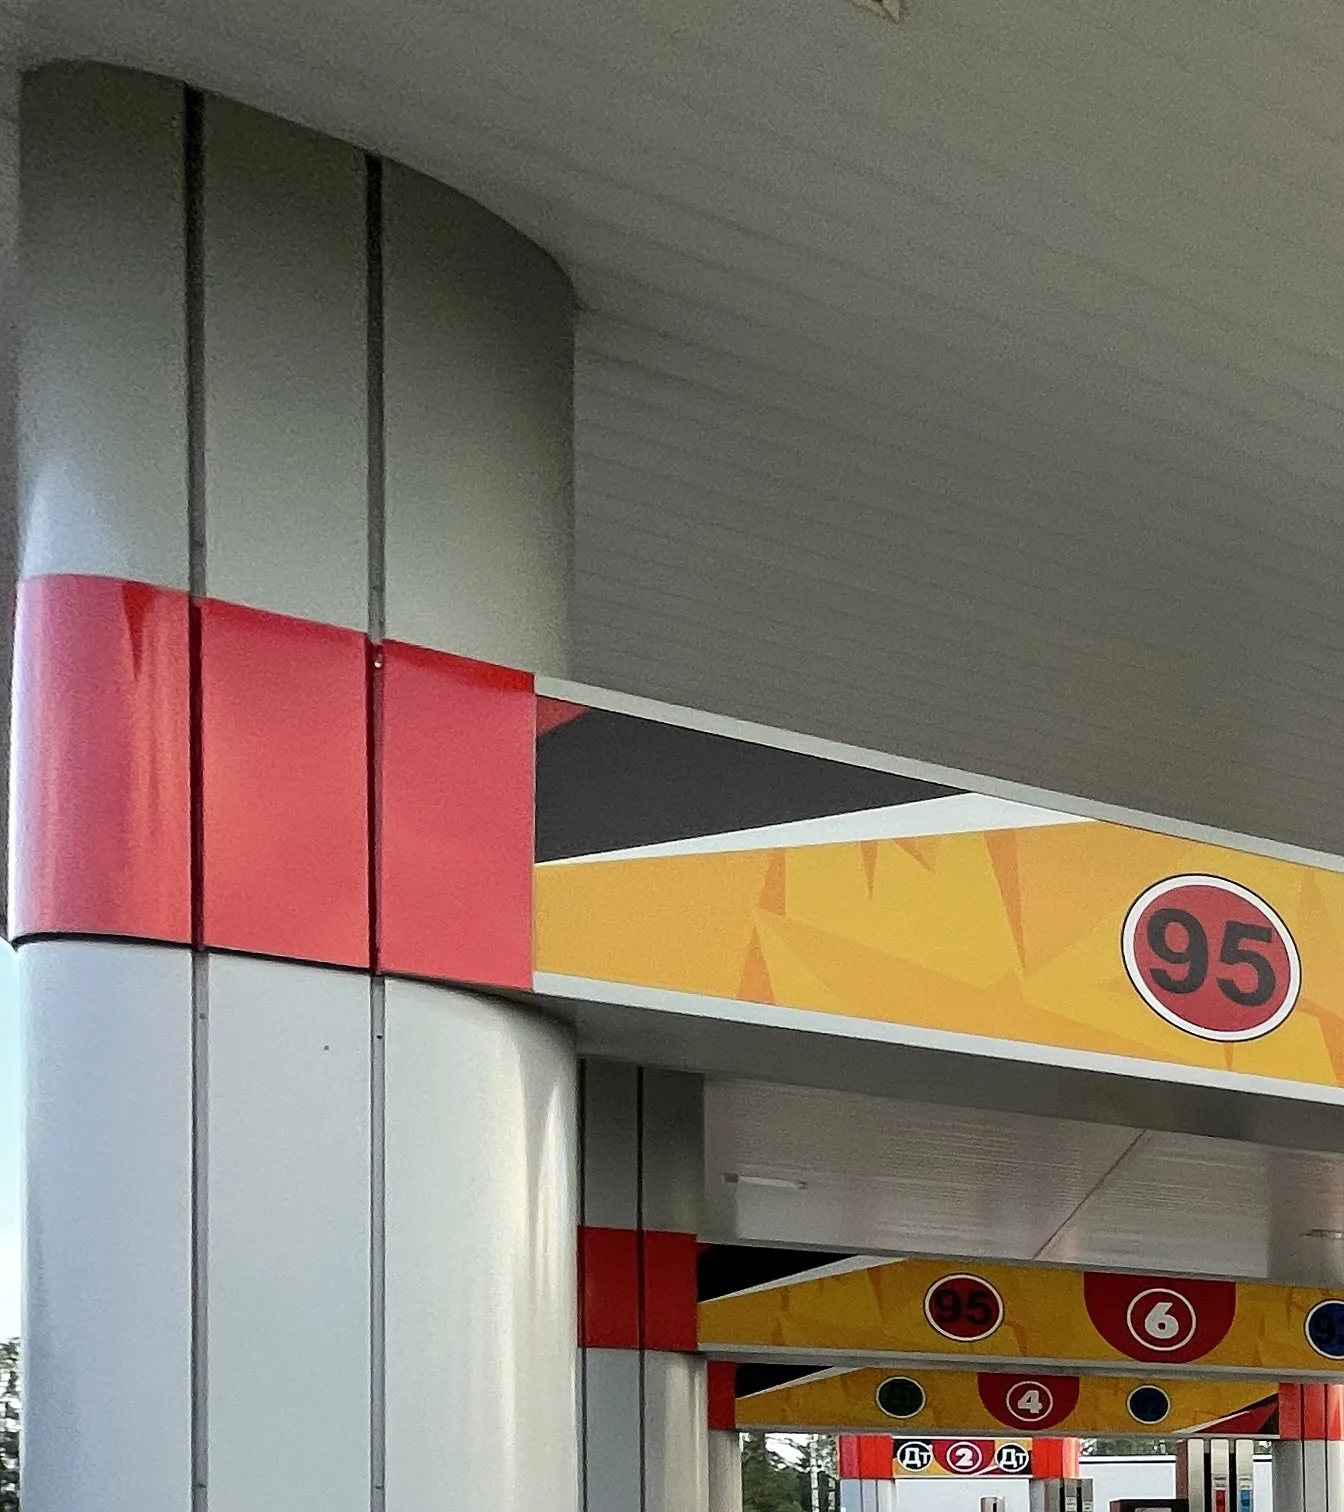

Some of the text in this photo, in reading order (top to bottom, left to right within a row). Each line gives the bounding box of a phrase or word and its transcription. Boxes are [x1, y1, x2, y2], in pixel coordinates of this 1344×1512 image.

[1147, 906, 1277, 1007] 95
[935, 1287, 994, 1326] 95
[1144, 1301, 1180, 1340] 6
[1017, 1389, 1043, 1414] 4
[954, 1447, 974, 1467] 2
